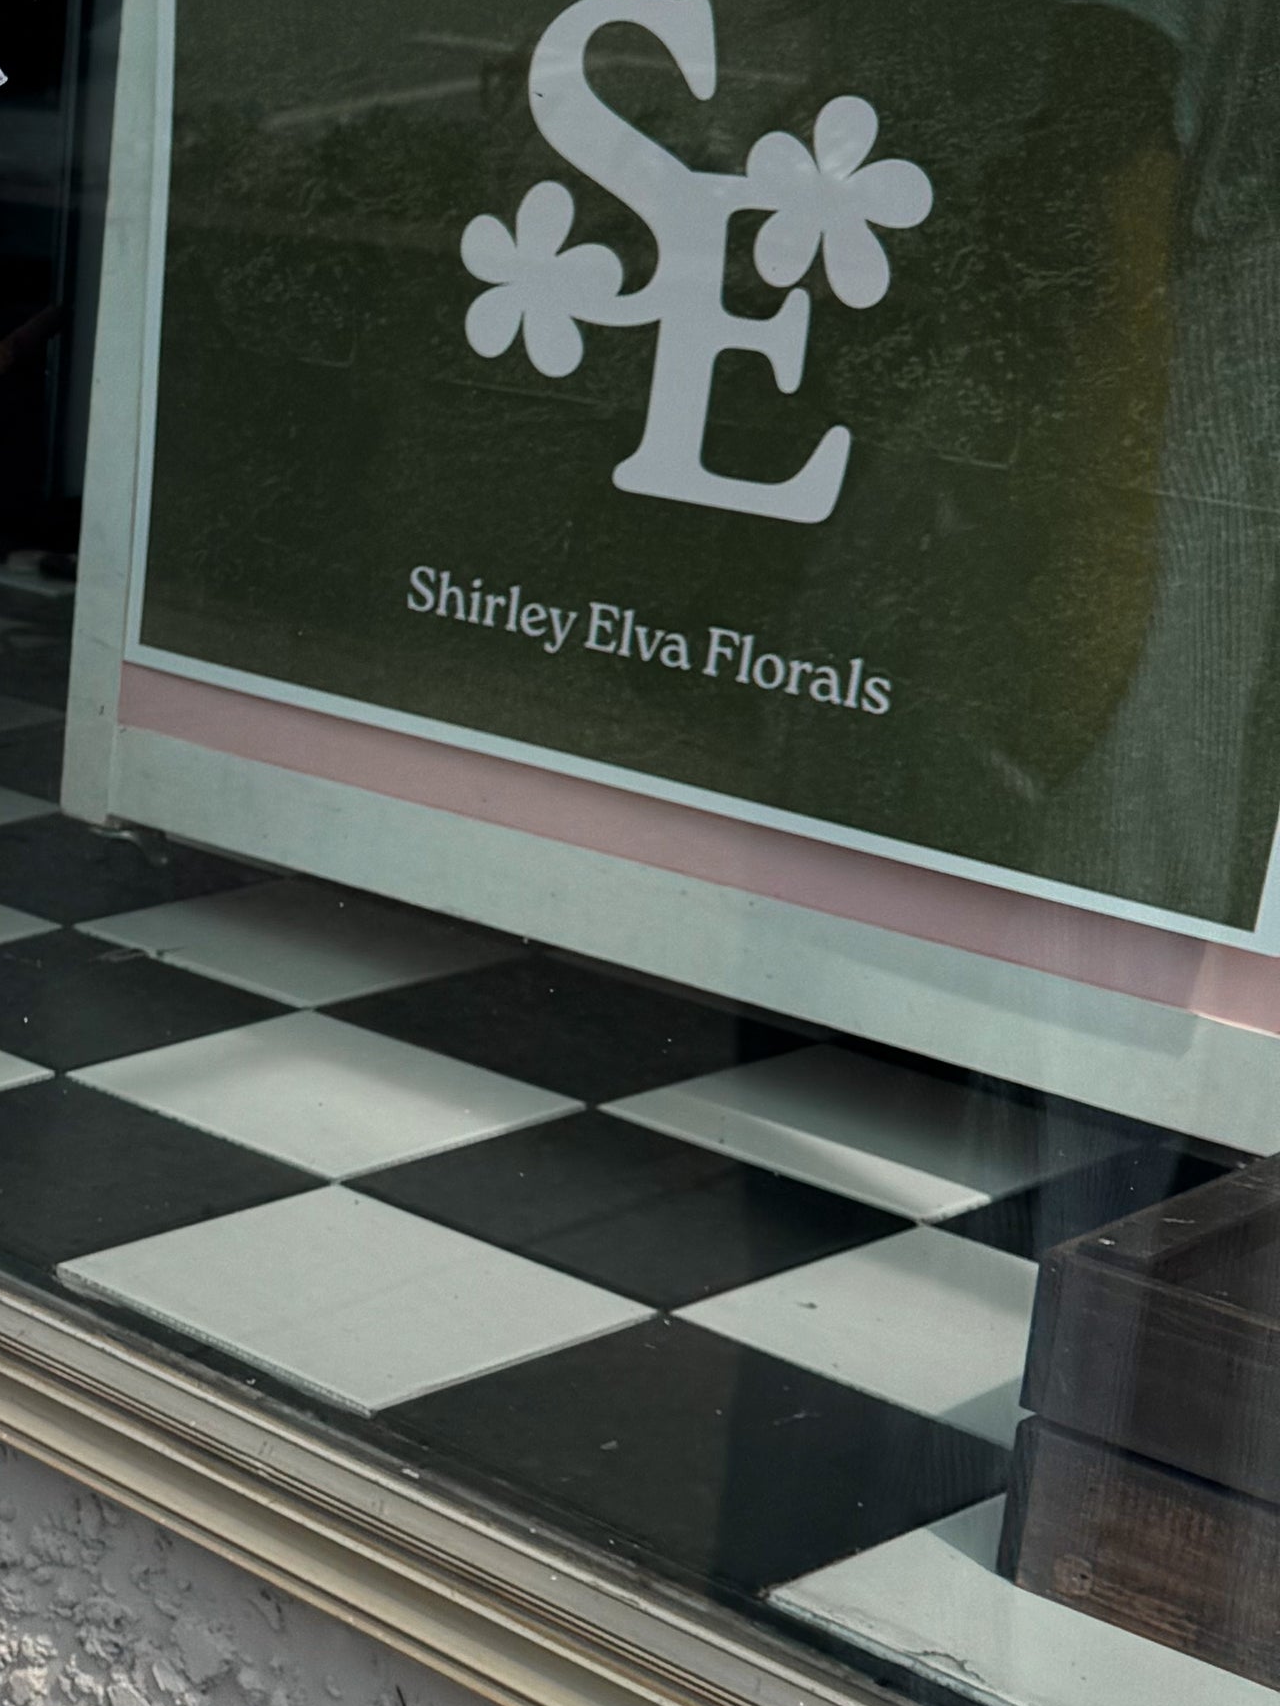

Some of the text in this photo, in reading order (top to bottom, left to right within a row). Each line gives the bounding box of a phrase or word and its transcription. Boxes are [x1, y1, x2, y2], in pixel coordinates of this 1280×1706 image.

[407, 565, 892, 715] Shirley Elva Florals
